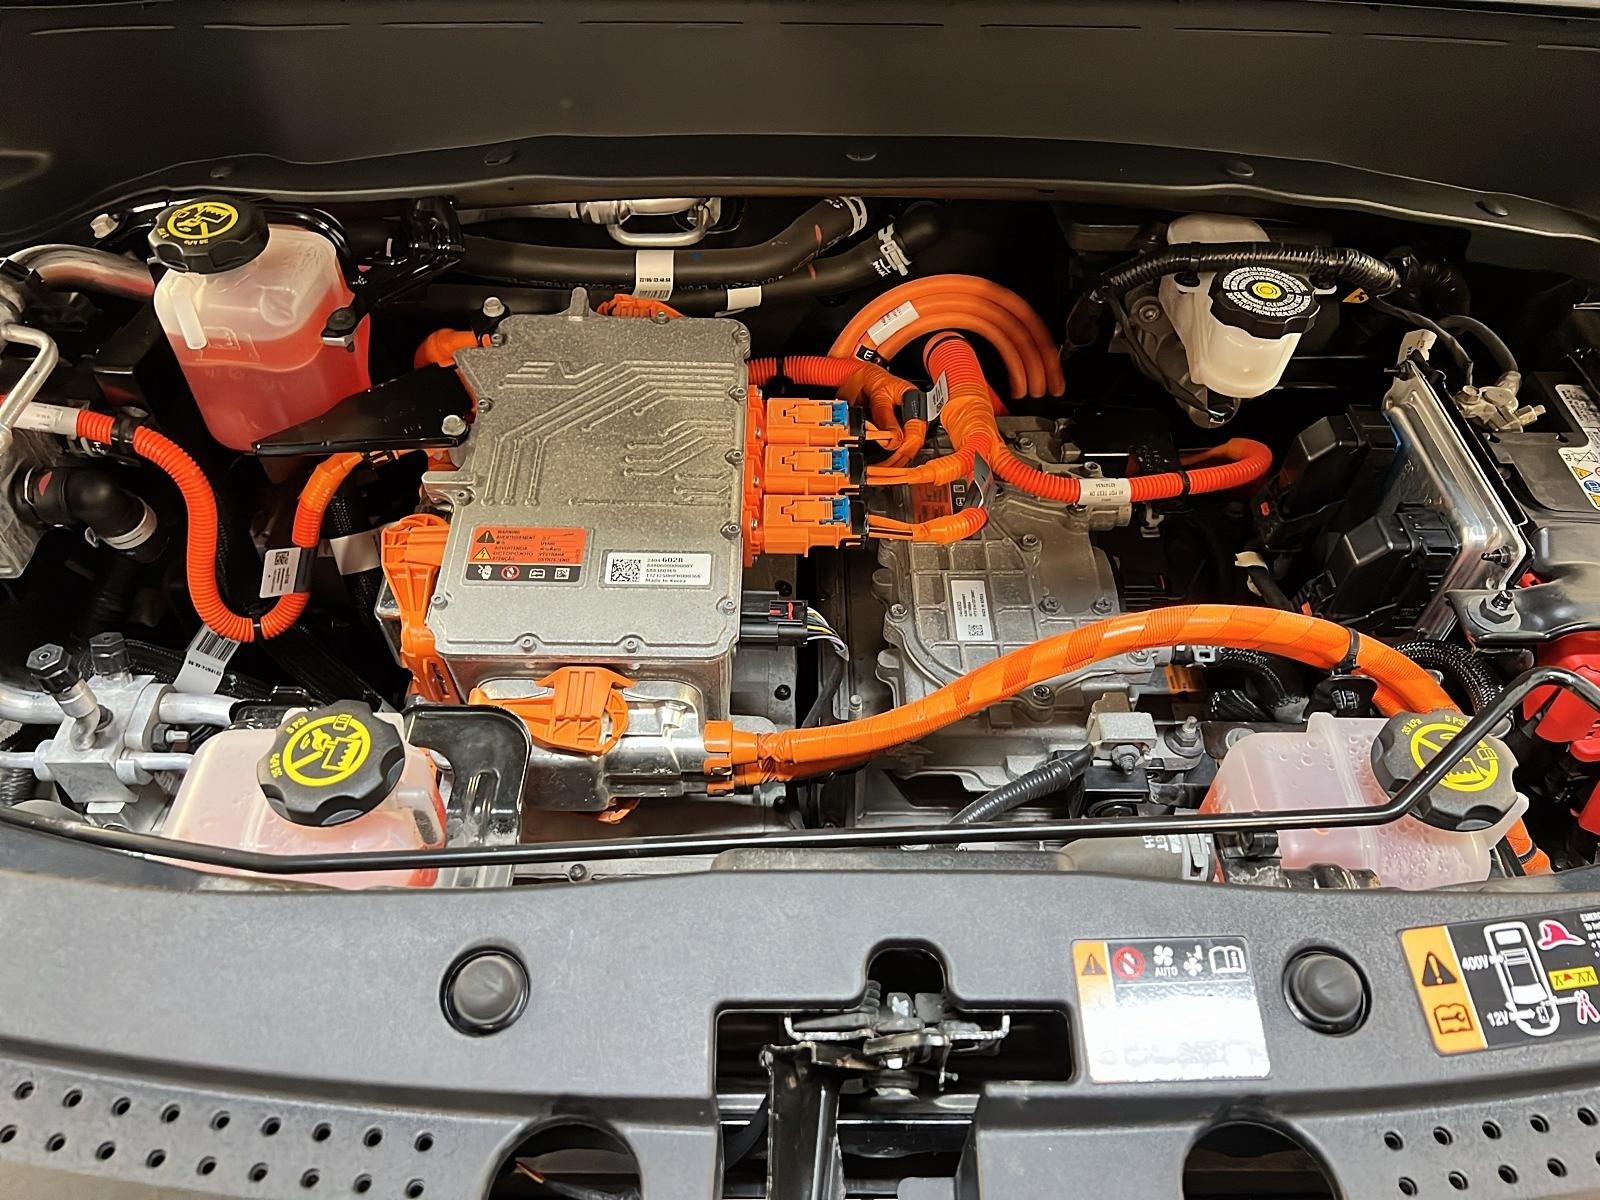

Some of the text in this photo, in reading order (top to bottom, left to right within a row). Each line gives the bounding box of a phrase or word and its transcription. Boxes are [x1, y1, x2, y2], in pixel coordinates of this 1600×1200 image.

[1252, 308, 1270, 316] FROM
[294, 716, 308, 729] PSI
[1462, 954, 1489, 971] 400V
[1155, 966, 1178, 977] AUTO
[1486, 1010, 1509, 1027] 12V
